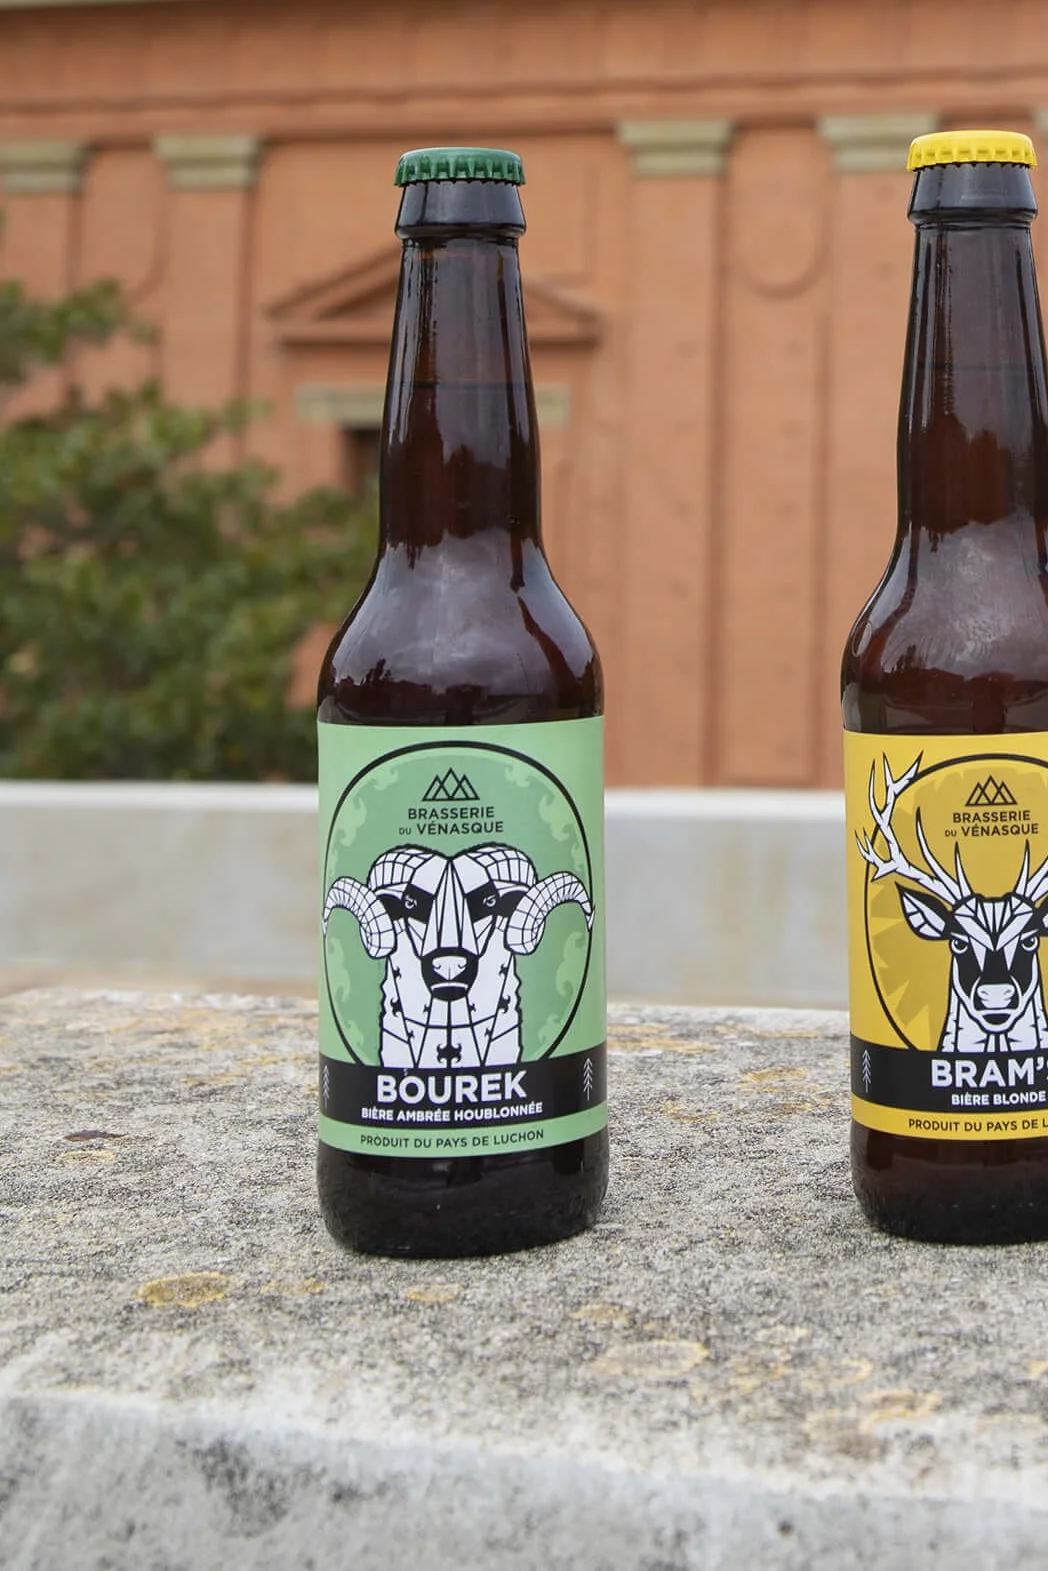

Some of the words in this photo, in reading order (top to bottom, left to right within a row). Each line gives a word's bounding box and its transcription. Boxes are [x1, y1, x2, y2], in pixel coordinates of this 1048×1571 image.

[408, 807, 495, 820] BRASSERIE
[953, 810, 1031, 823] BRASSERIE
[417, 821, 504, 835] VÉNASQUE
[961, 823, 1039, 837] VÉNASQUE
[376, 1070, 527, 1104] BOUREK
[951, 1092, 990, 1106] BIÈRE
[993, 1090, 1047, 1105] BLONDE
[361, 1106, 394, 1120] BIÈRE
[397, 1108, 450, 1122] AMBRÉE
[454, 1101, 543, 1121] HOUBLONNÉE
[908, 1118, 960, 1132] PRODUIT
[964, 1122, 982, 1132] DU
[986, 1121, 1017, 1132] PAYS
[1022, 1119, 1038, 1129] DE
[360, 1135, 409, 1148] PRODUIT
[414, 1138, 431, 1148] DU
[436, 1138, 467, 1148] PAYS
[472, 1136, 488, 1146] DE
[494, 1129, 544, 1145] LUCHON
